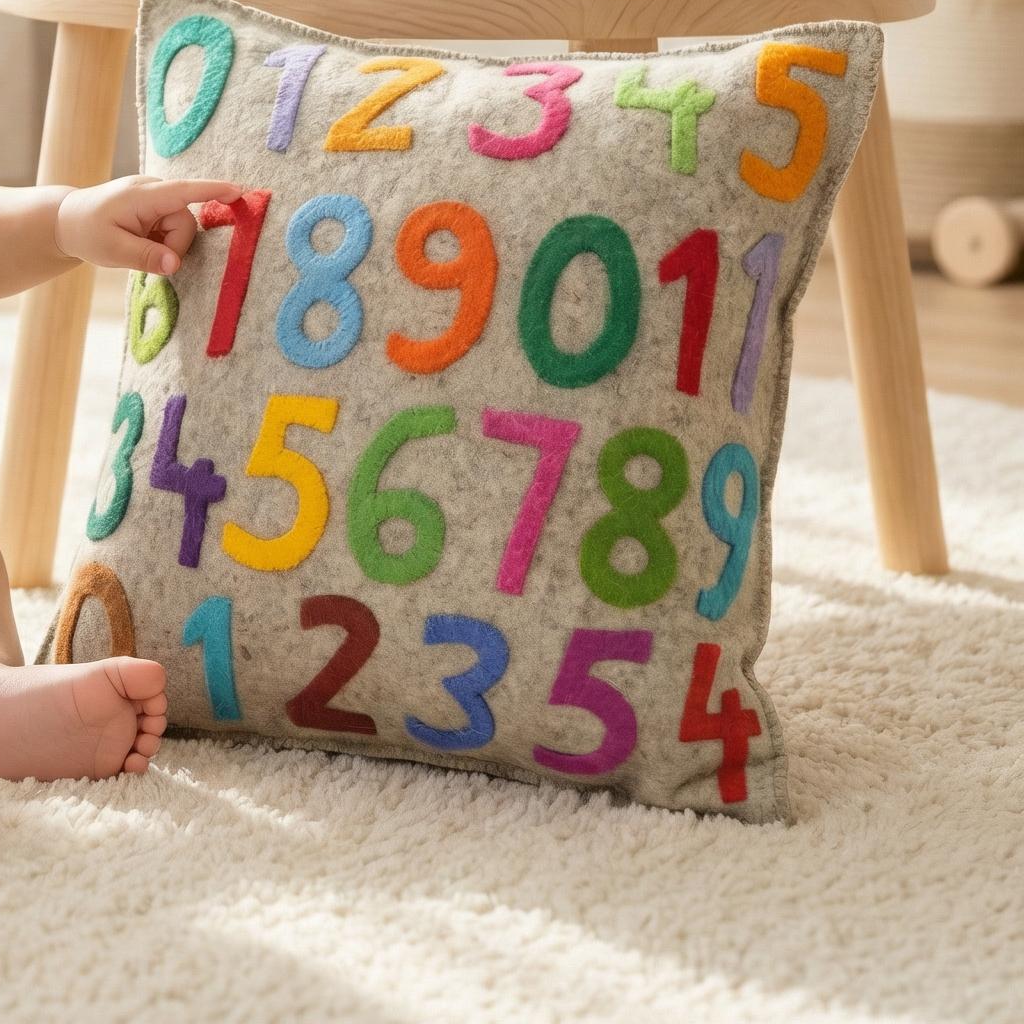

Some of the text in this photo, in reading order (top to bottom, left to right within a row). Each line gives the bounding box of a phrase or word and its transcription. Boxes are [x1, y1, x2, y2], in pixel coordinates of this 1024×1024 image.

[147, 14, 849, 203] 0 1 2 3 4 5
[199, 189, 272, 359] 7
[275, 194, 374, 370] 8
[385, 200, 499, 375] 9
[517, 214, 641, 389] 0
[657, 228, 720, 397] 1
[730, 231, 786, 414] 1
[85, 391, 760, 622] 3 4 5 6 7 8 9
[181, 594, 242, 722] 1
[285, 594, 380, 737] 2
[404, 614, 511, 752] 3
[532, 628, 654, 777] 5
[678, 642, 762, 806] 4
